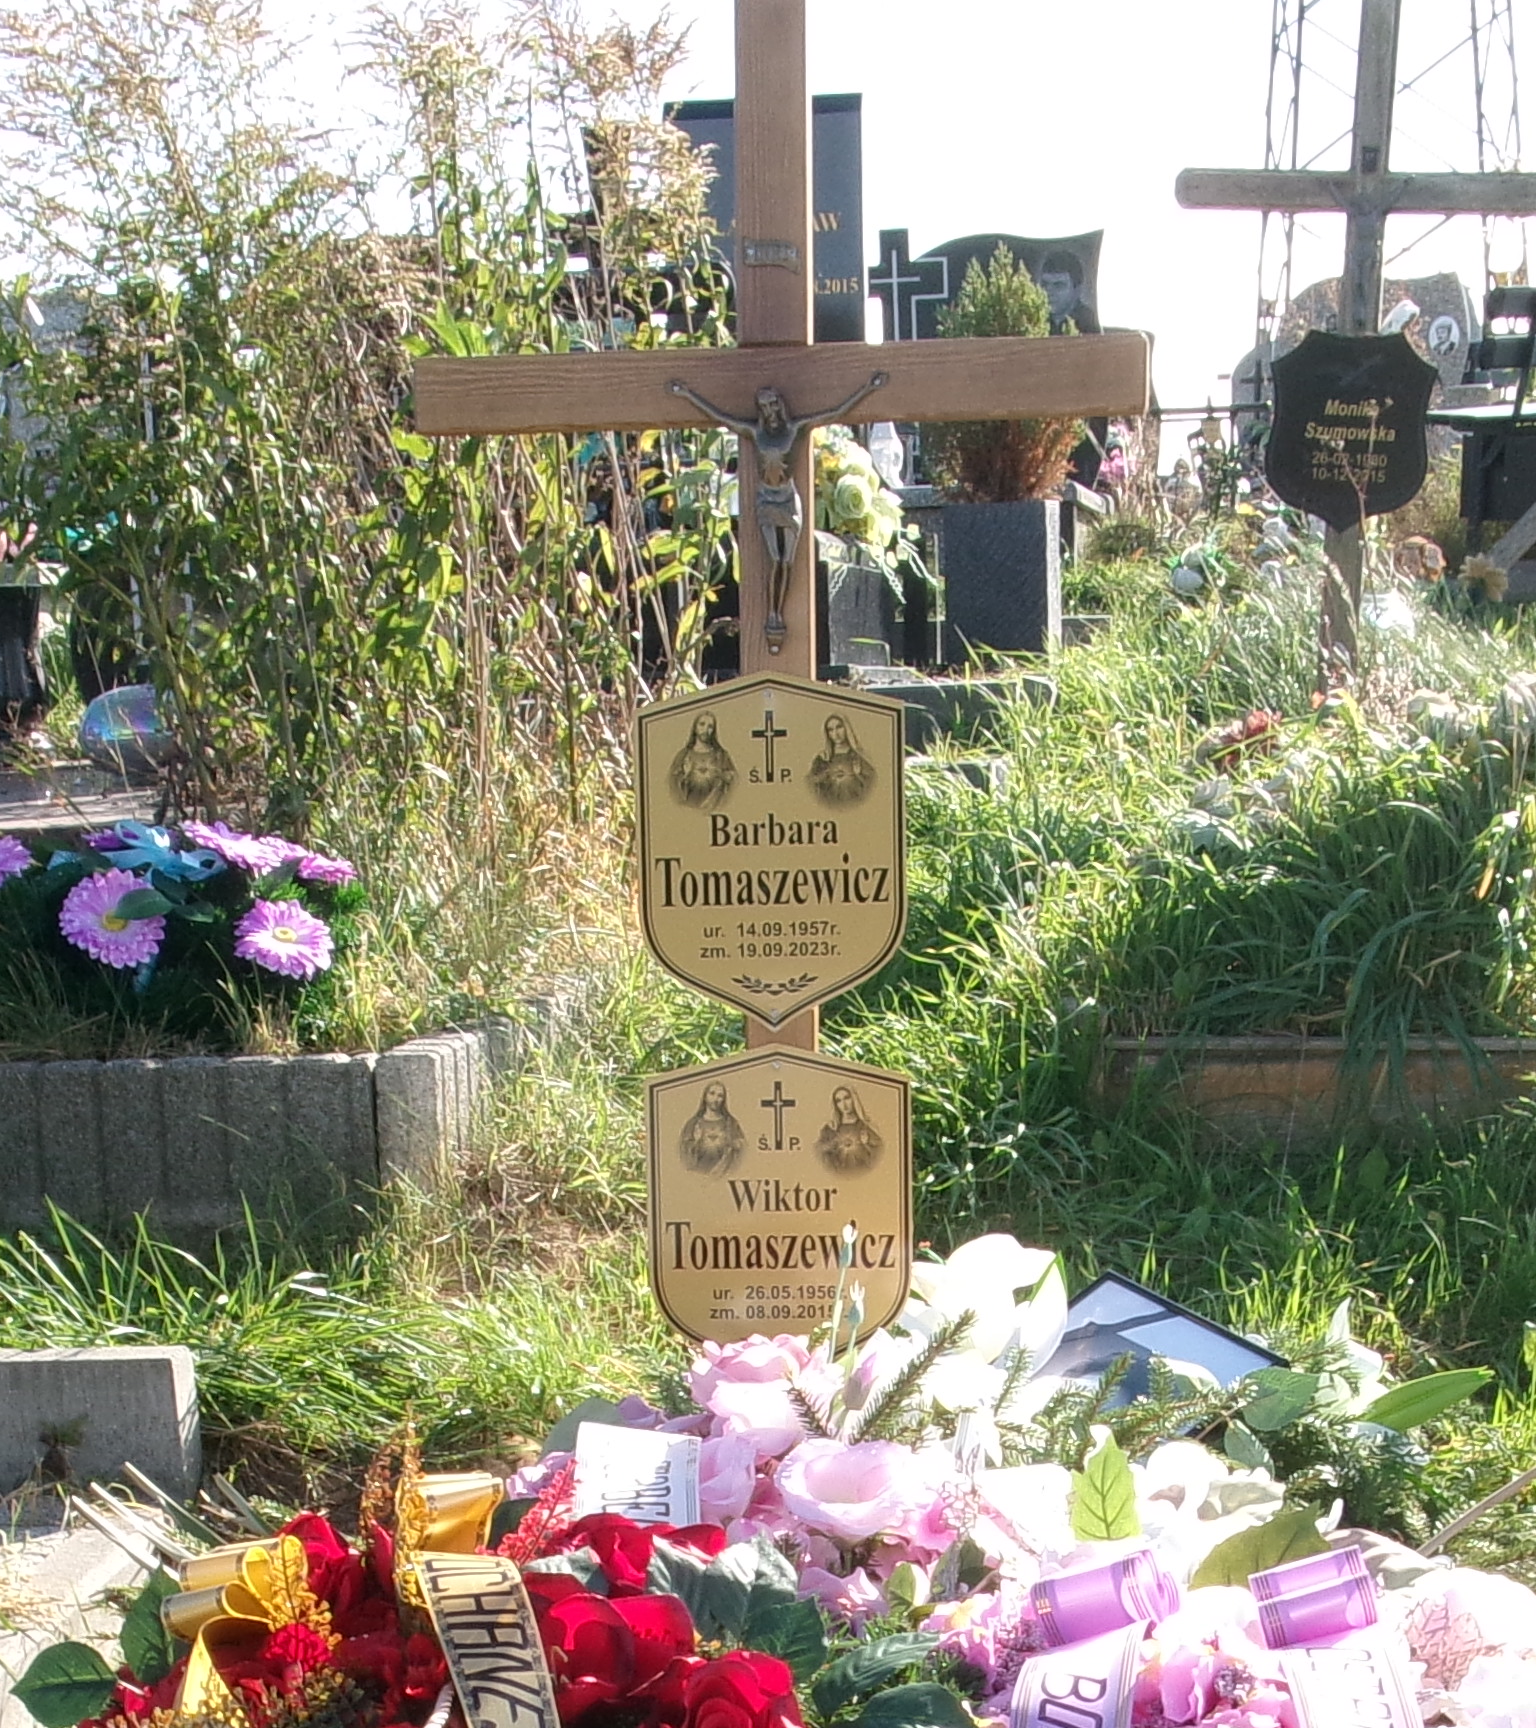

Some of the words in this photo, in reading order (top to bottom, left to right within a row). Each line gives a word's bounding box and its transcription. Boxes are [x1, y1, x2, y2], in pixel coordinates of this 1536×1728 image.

[710, 813, 839, 848] Barbara
[655, 852, 891, 908] Tomaszewicz
[703, 924, 726, 939] ur.
[736, 920, 841, 938] 14.09.1957r.
[700, 946, 731, 959] zm.
[737, 942, 841, 959] 19.09.2023r.
[727, 1179, 838, 1213] Wiktor
[665, 1219, 897, 1271] Tomaszewicz
[712, 1287, 735, 1301] ur.
[709, 1308, 740, 1321] zm.
